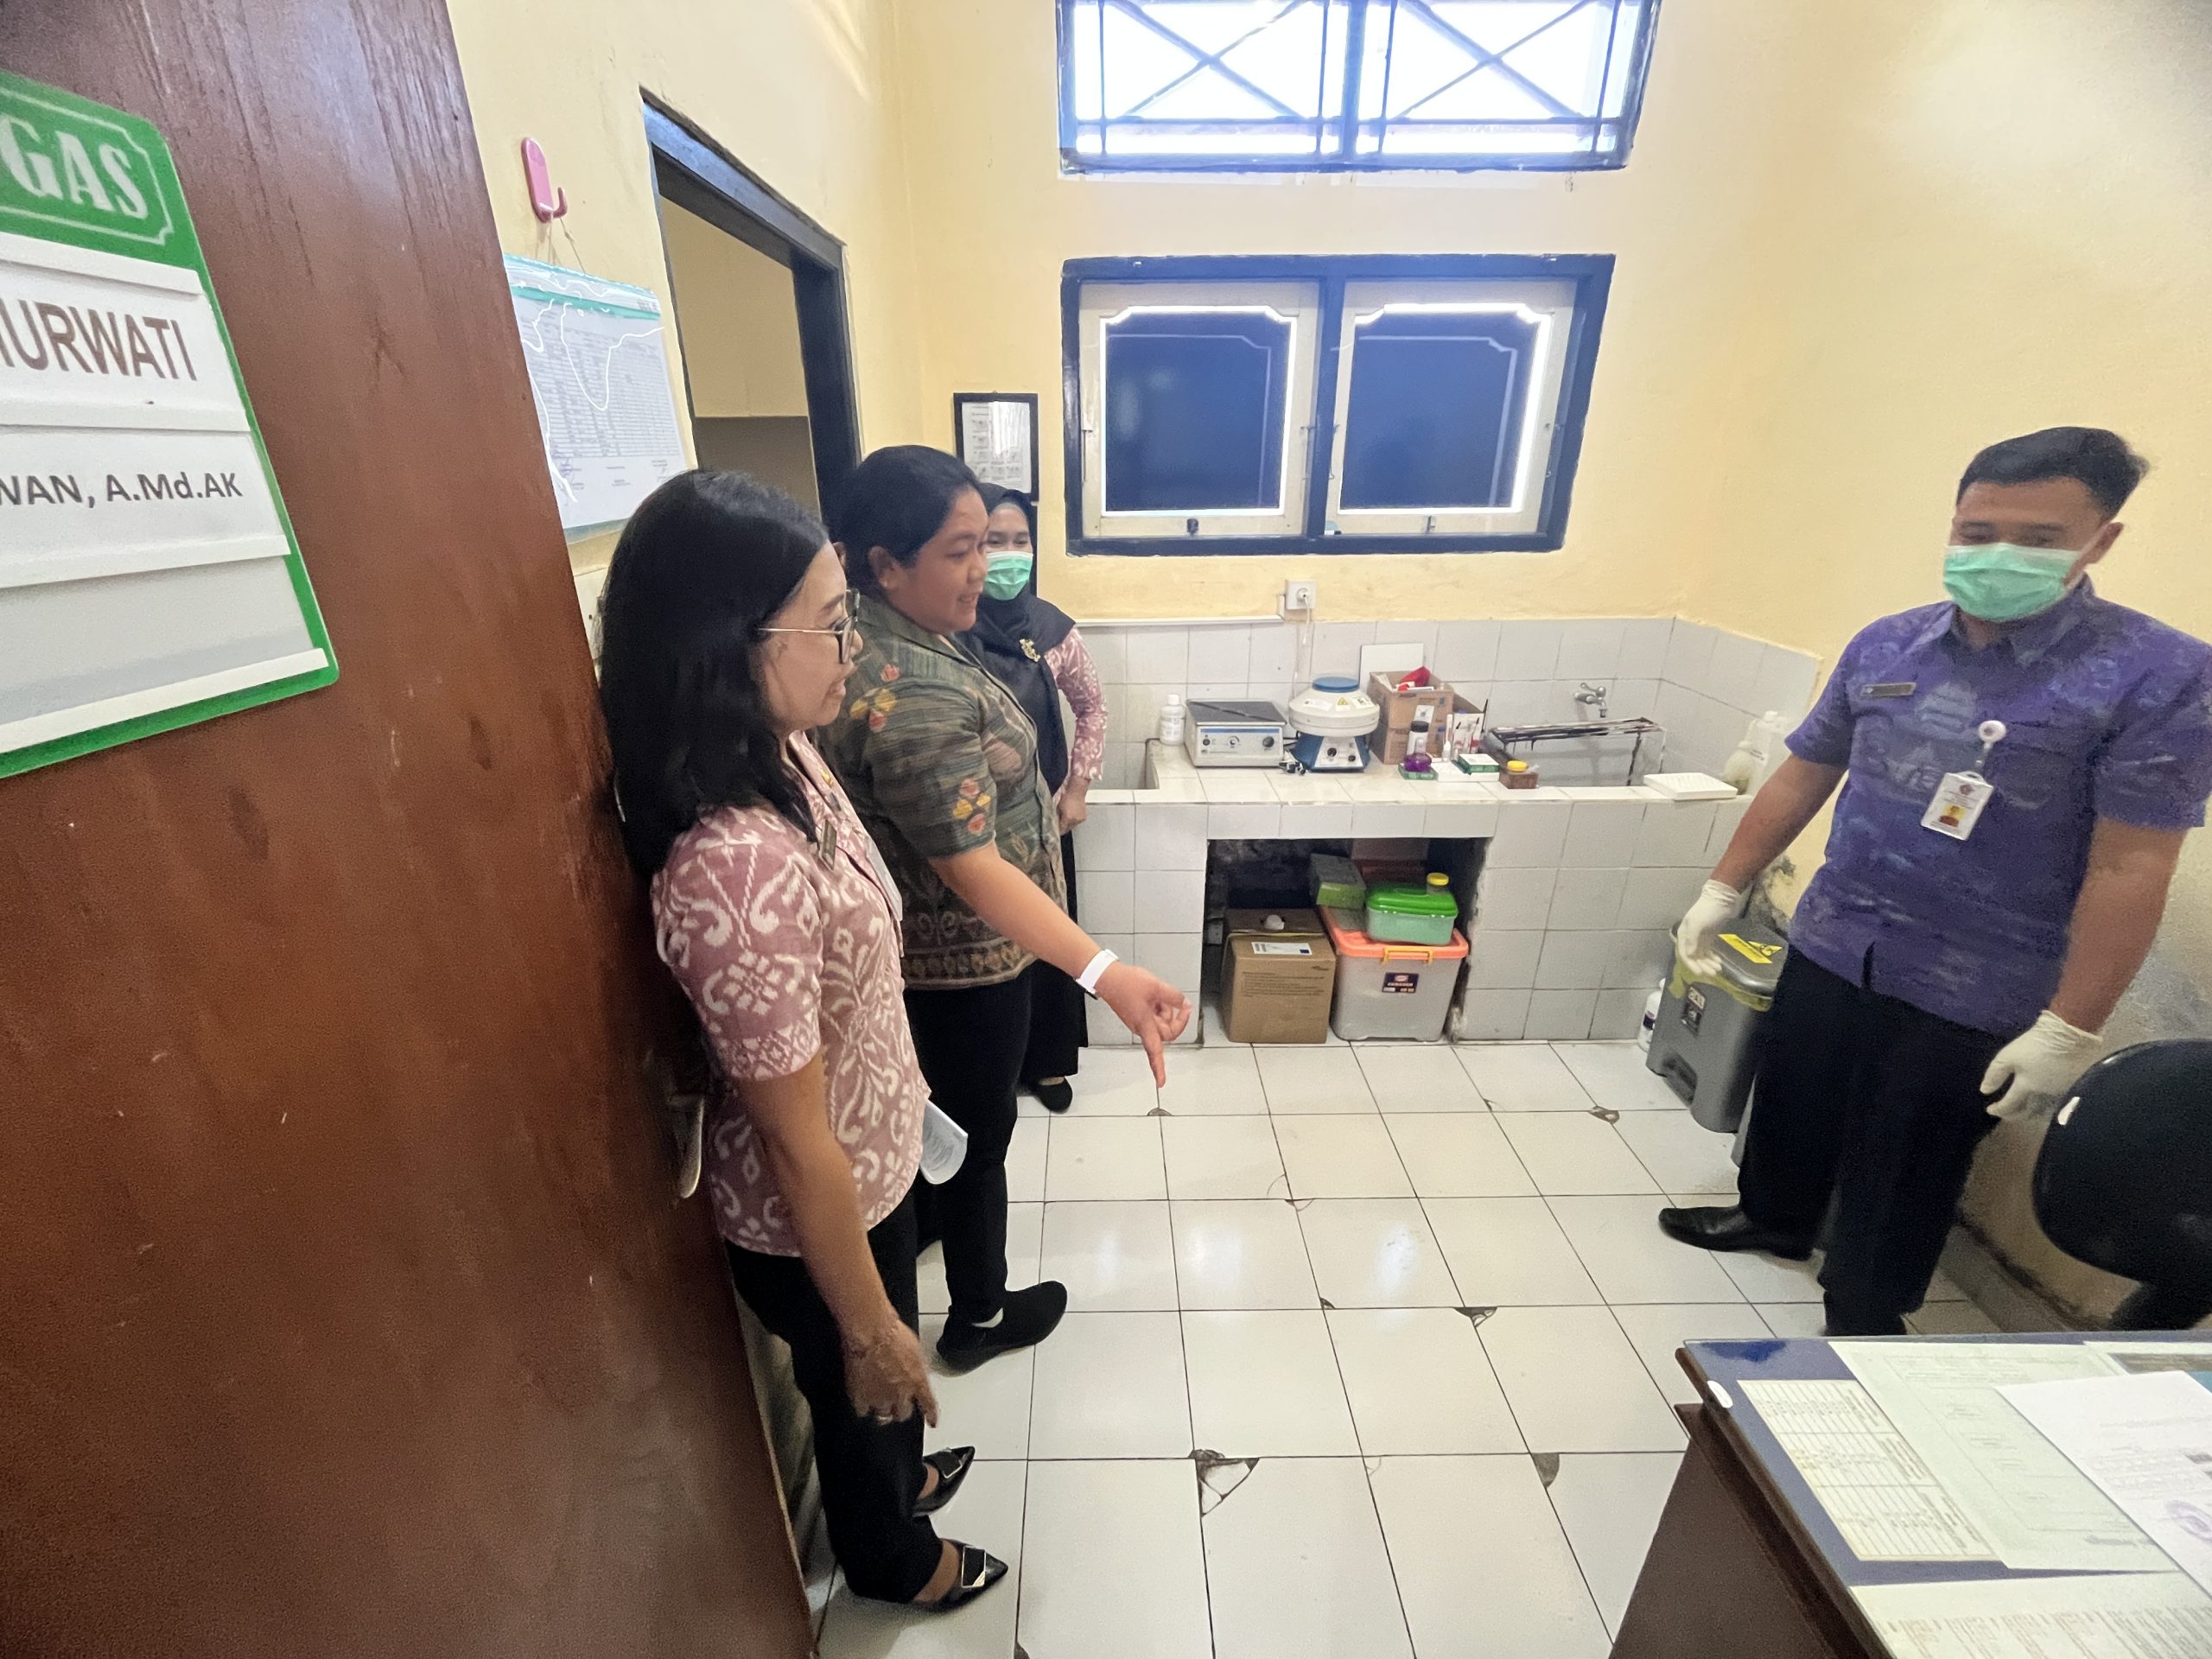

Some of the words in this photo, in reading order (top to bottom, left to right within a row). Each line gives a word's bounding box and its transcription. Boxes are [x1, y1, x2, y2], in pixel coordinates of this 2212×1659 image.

[0, 113, 149, 219] GAS
[0, 296, 198, 381] URWATI
[106, 471, 243, 502] A.Md.AK
